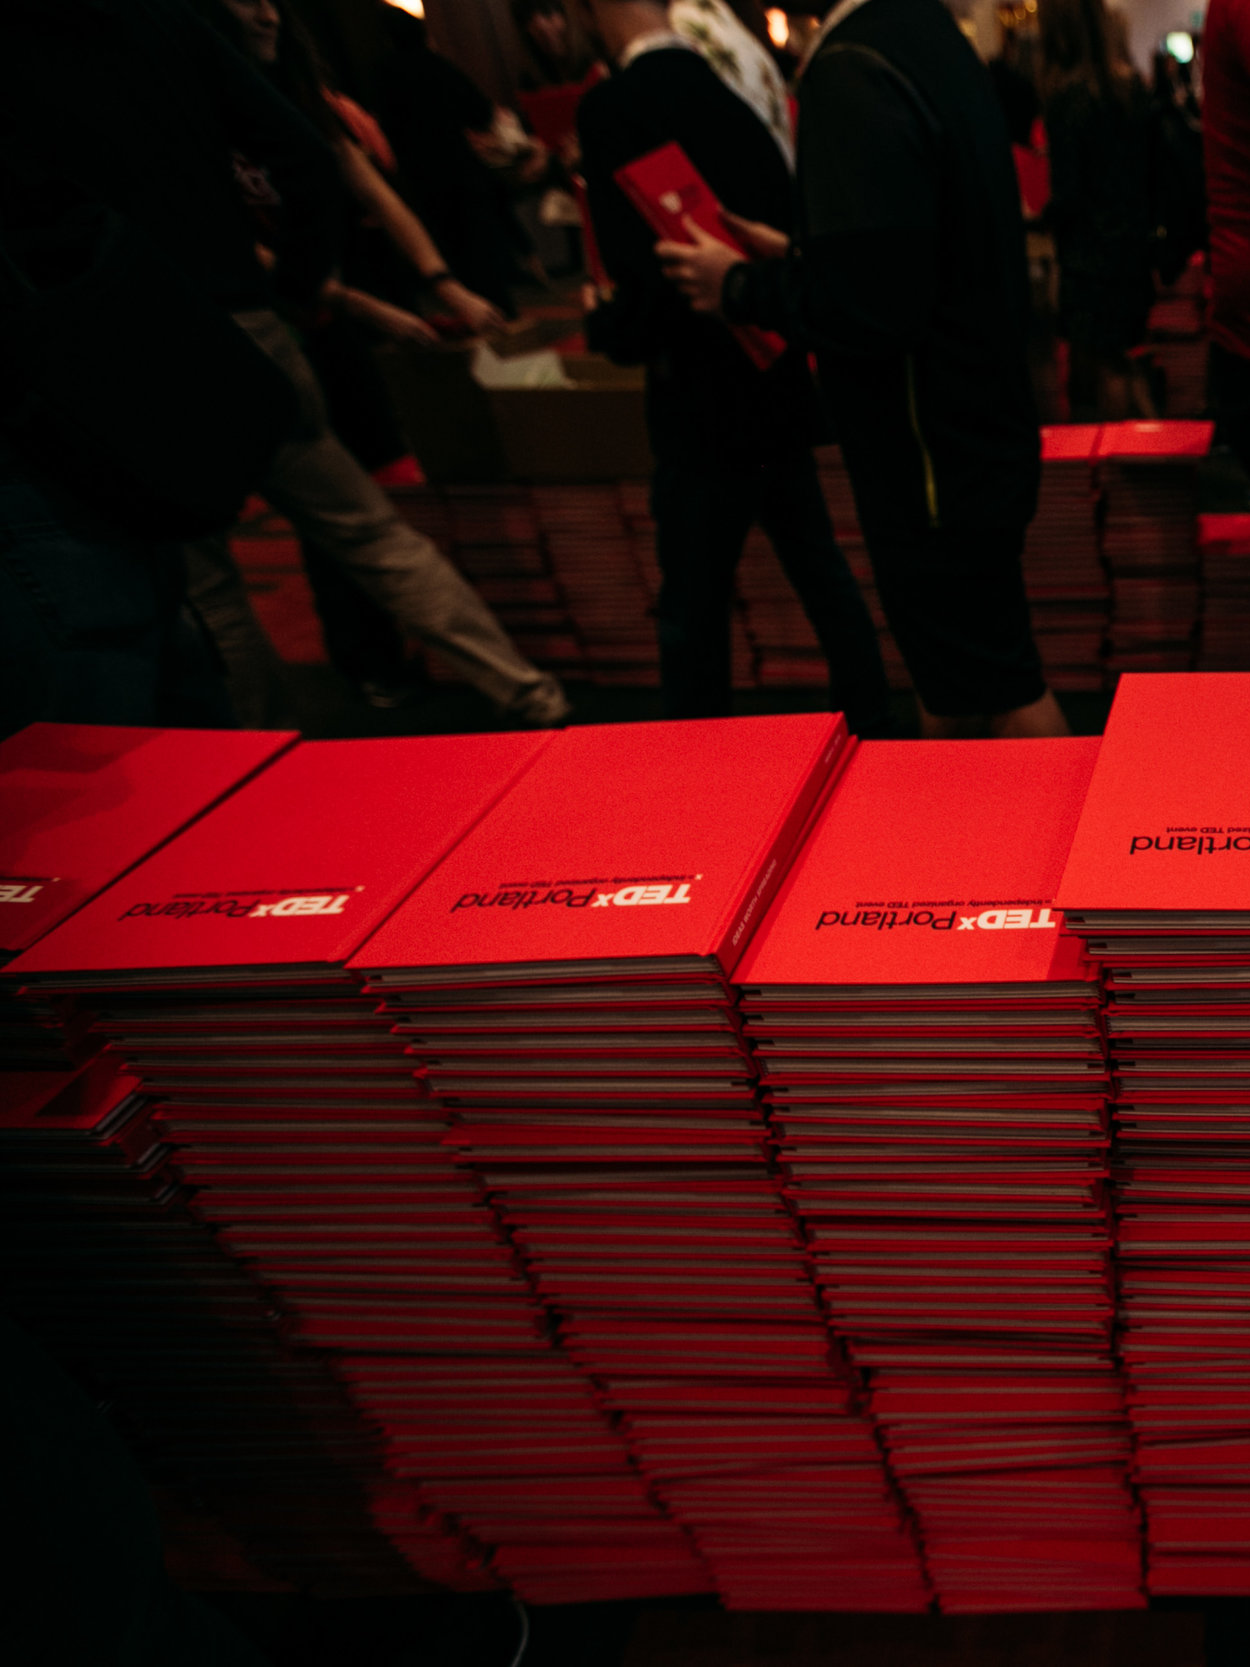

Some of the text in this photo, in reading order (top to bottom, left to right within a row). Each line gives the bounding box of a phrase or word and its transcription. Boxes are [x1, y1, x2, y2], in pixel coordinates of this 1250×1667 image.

[1166, 826, 1198, 834] event
[1200, 826, 1224, 834] TED
[912, 900, 965, 908] organized
[967, 898, 1043, 907] independently
